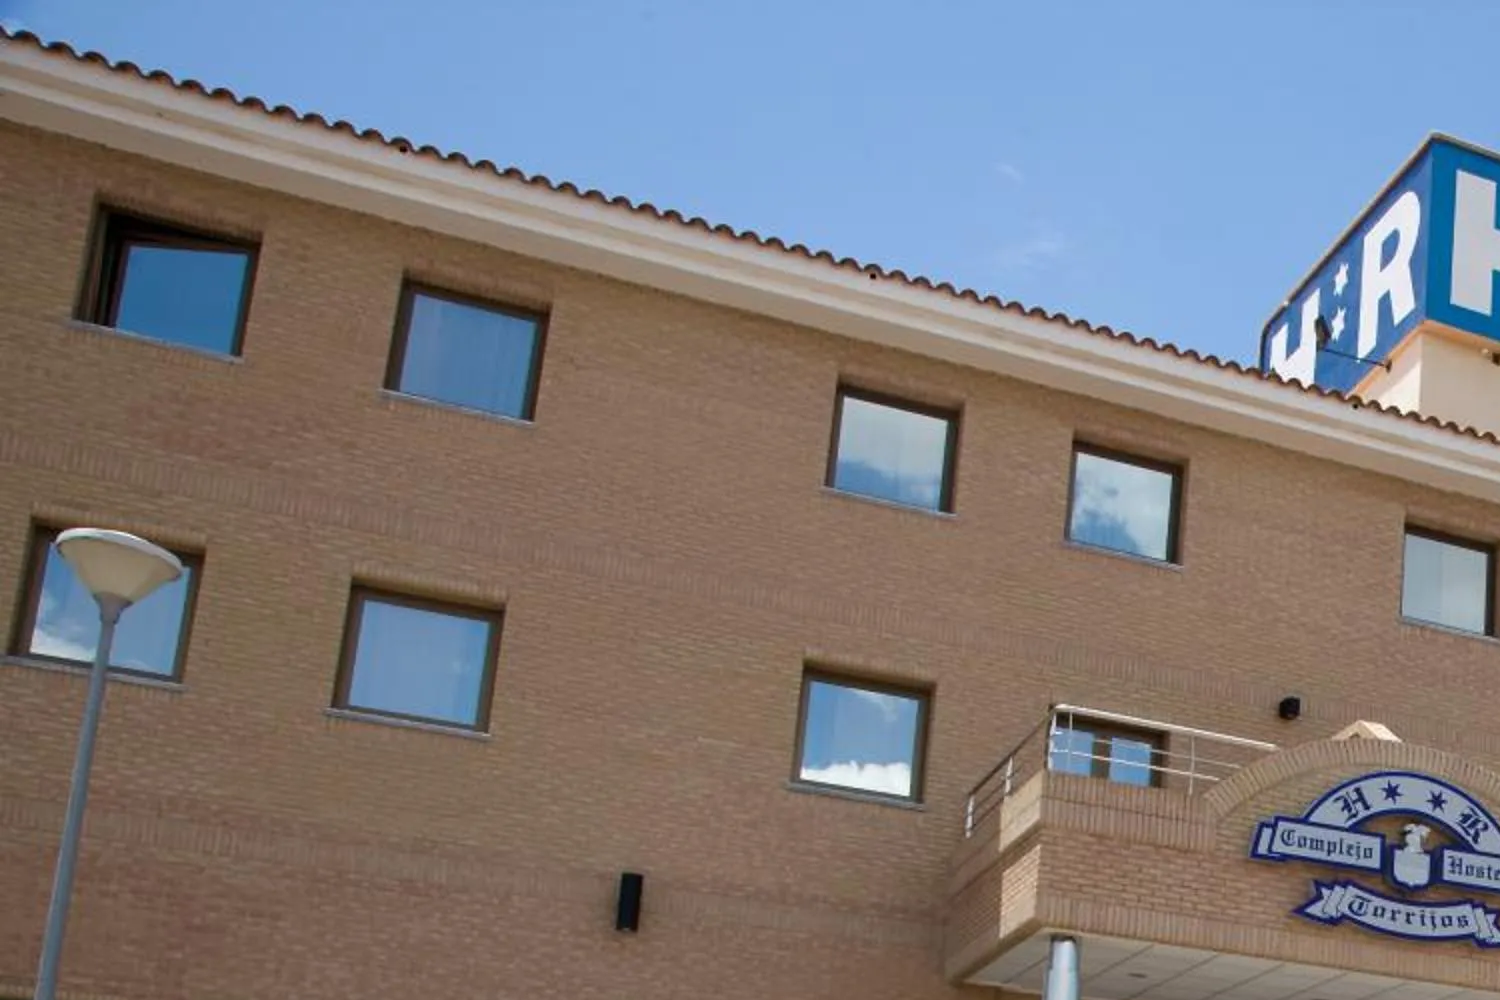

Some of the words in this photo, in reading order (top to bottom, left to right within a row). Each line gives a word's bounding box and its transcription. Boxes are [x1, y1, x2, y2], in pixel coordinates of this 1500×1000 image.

[1357, 191, 1421, 362] R
[1458, 805, 1491, 845] R
[1279, 828, 1374, 861] Complejo
[1347, 896, 1470, 932] Torrijos
